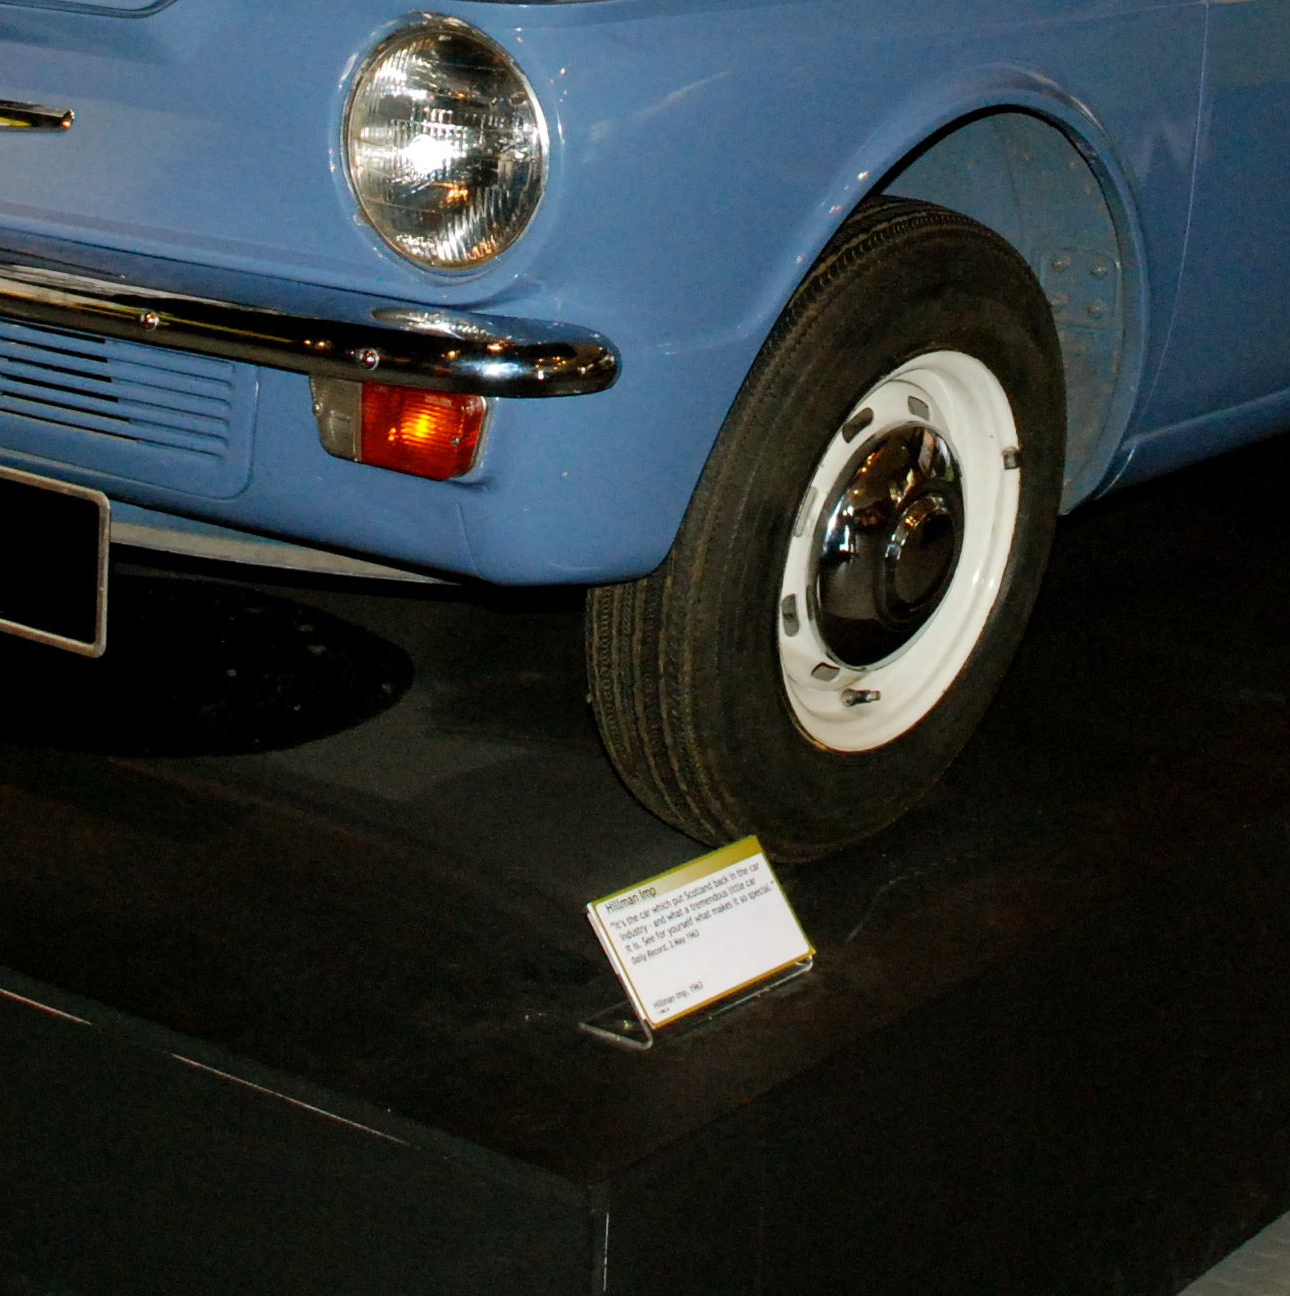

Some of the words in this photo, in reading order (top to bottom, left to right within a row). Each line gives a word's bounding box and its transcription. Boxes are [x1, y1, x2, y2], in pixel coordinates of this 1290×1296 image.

[606, 895, 639, 912] Hillman
[639, 888, 656, 899] Imp
[653, 901, 671, 913] which
[672, 895, 683, 906] put
[684, 882, 713, 900] Scotland
[713, 877, 728, 887] back
[749, 863, 759, 871] car
[668, 909, 683, 920] what
[690, 890, 728, 911] tremendous
[746, 878, 755, 887] car
[667, 916, 693, 937] yourself
